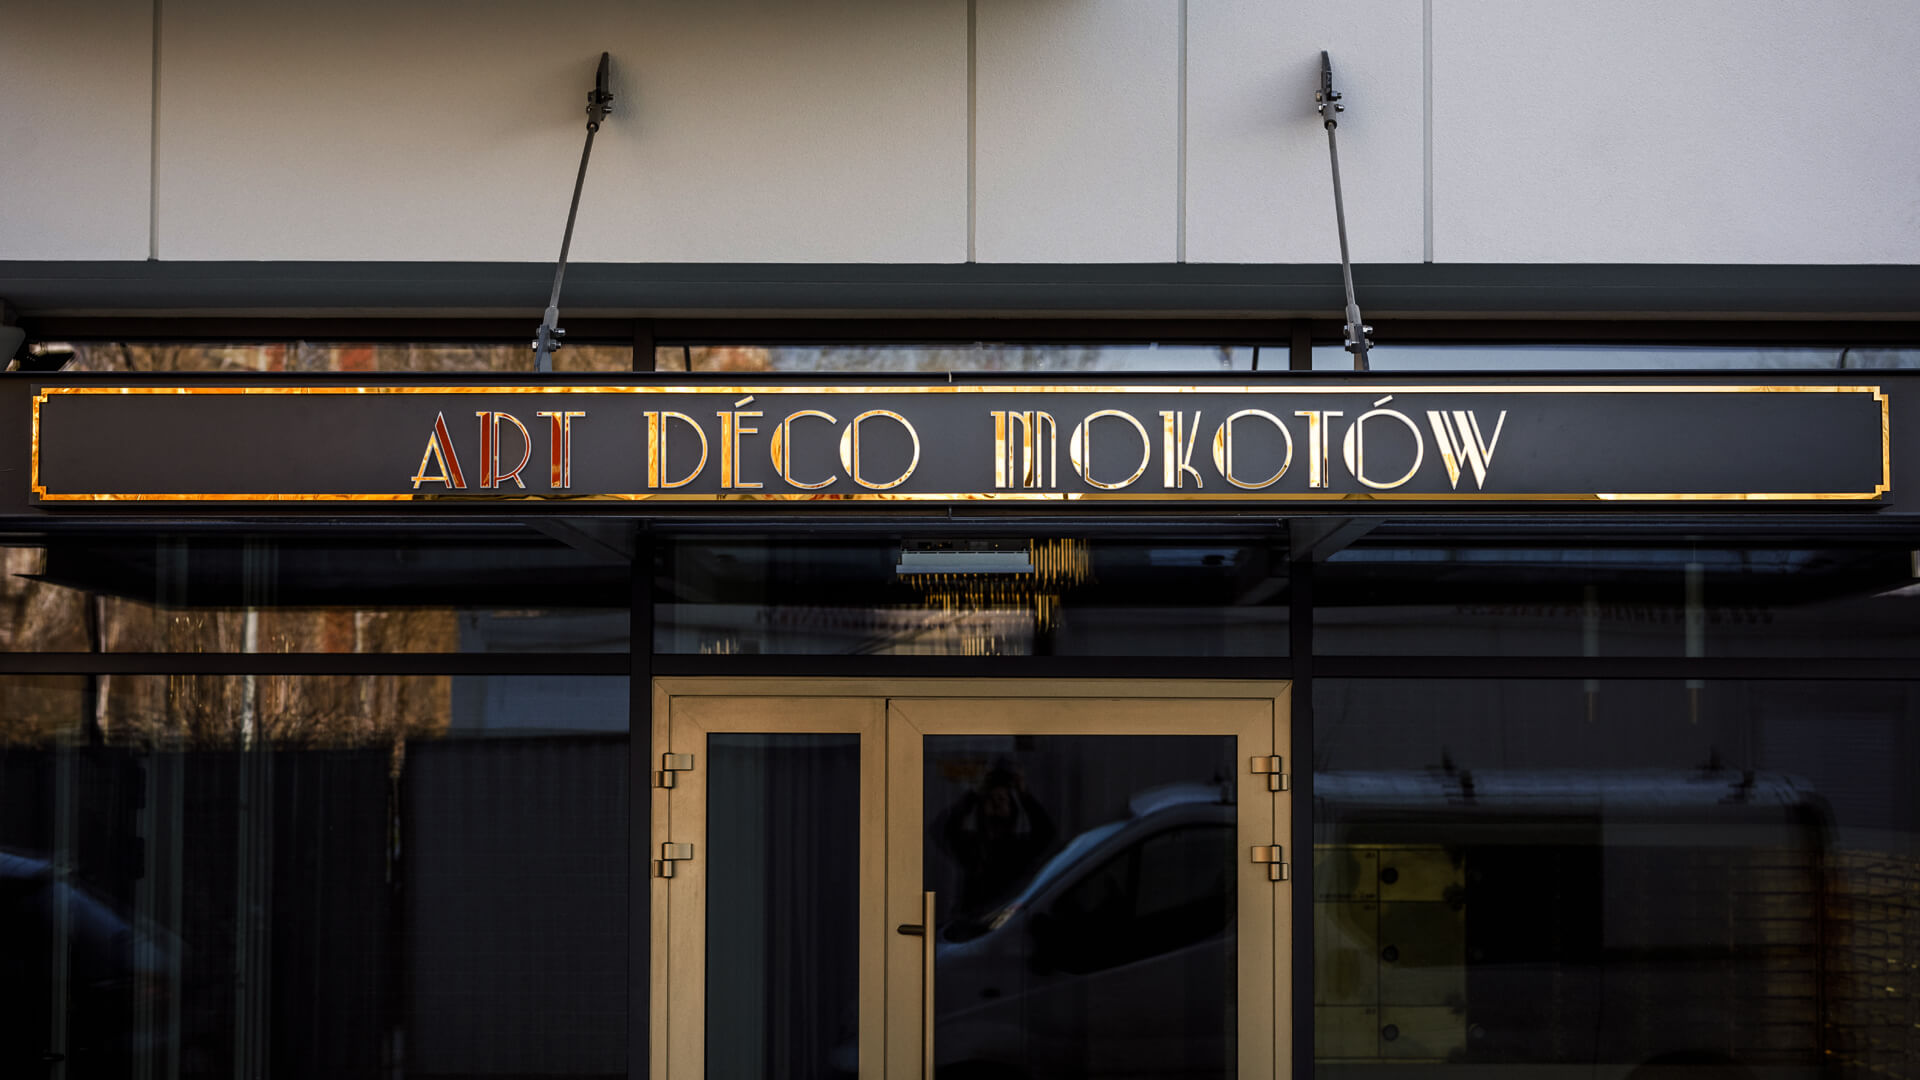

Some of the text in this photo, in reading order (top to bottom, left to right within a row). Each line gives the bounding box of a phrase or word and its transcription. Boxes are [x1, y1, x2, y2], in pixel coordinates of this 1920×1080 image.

[411, 395, 1507, 489] ART DÉCO MOKOTÓW
